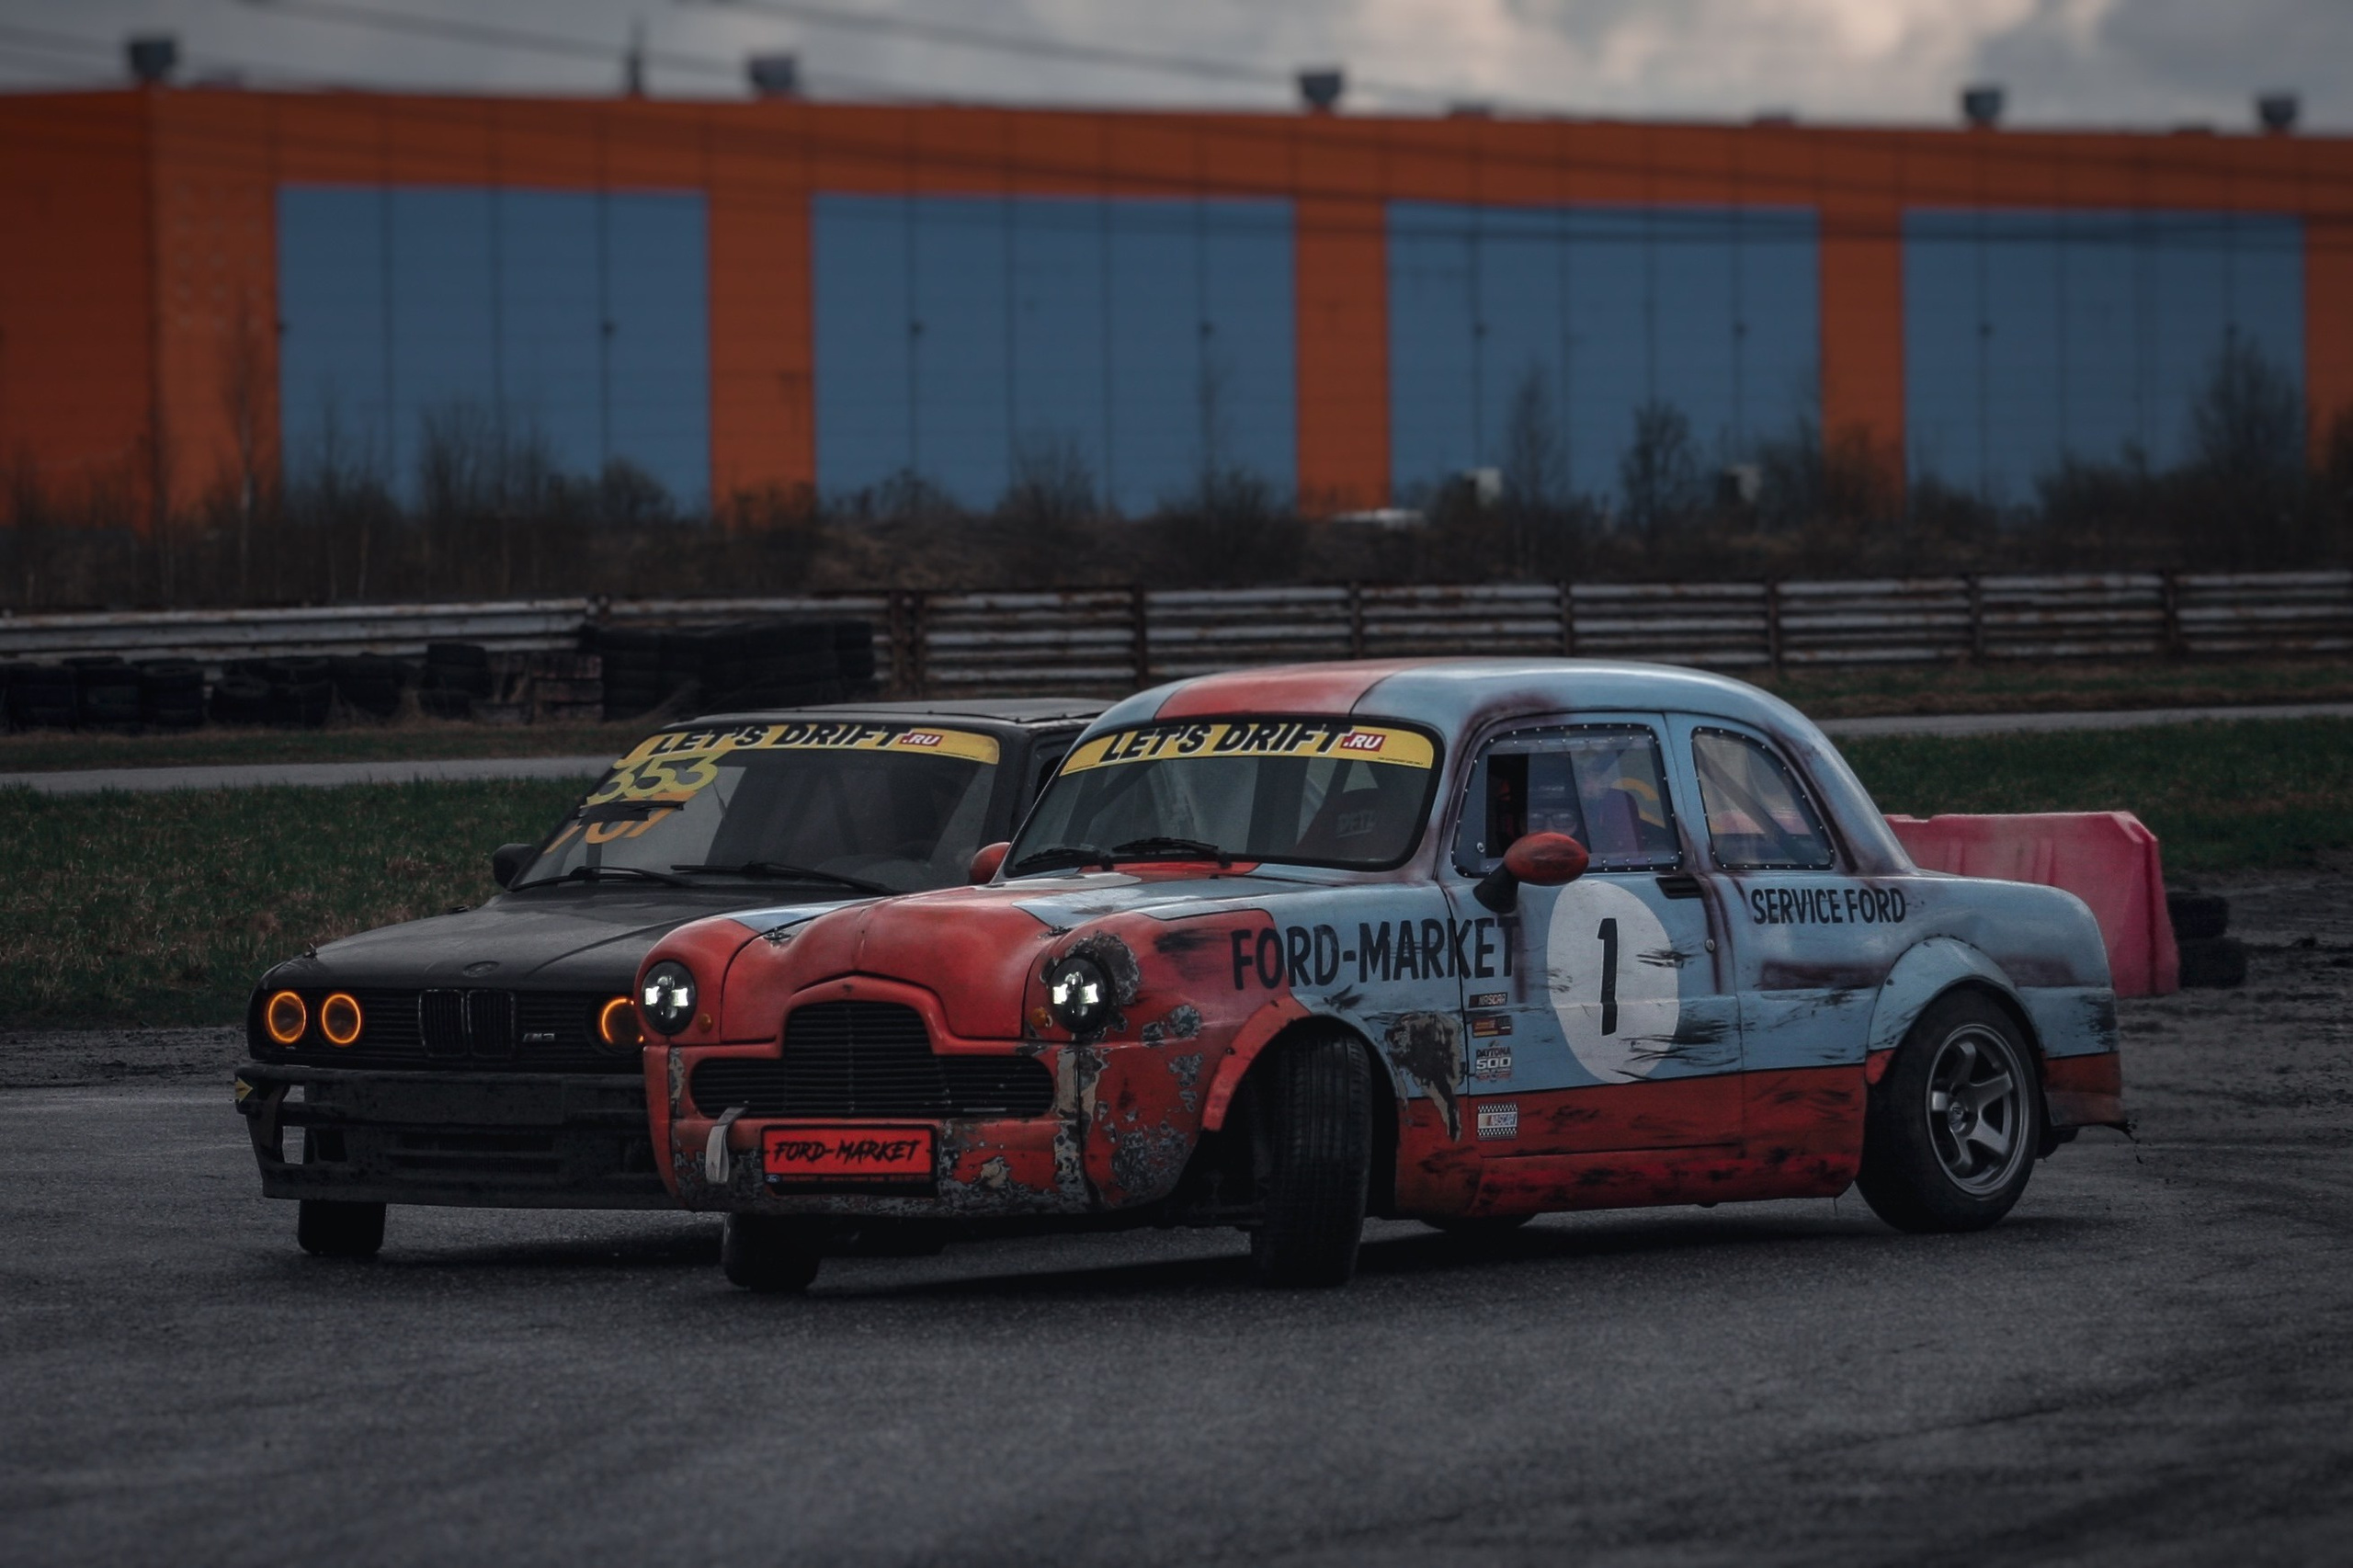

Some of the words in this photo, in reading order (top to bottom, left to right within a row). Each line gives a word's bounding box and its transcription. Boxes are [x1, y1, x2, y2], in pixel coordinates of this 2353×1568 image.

[647, 723, 765, 756] LET'S
[1099, 723, 1214, 763] LET'S
[586, 751, 726, 805] 353
[1751, 888, 1843, 925] SERVICE
[1844, 887, 1906, 924] FORD
[1231, 917, 1520, 991] FORD-MARKET
[1597, 917, 1618, 1037] 1
[1476, 1046, 1512, 1058] DAYTONA
[1476, 1056, 1512, 1070] 500
[773, 1139, 922, 1165] FORD-MARKET
